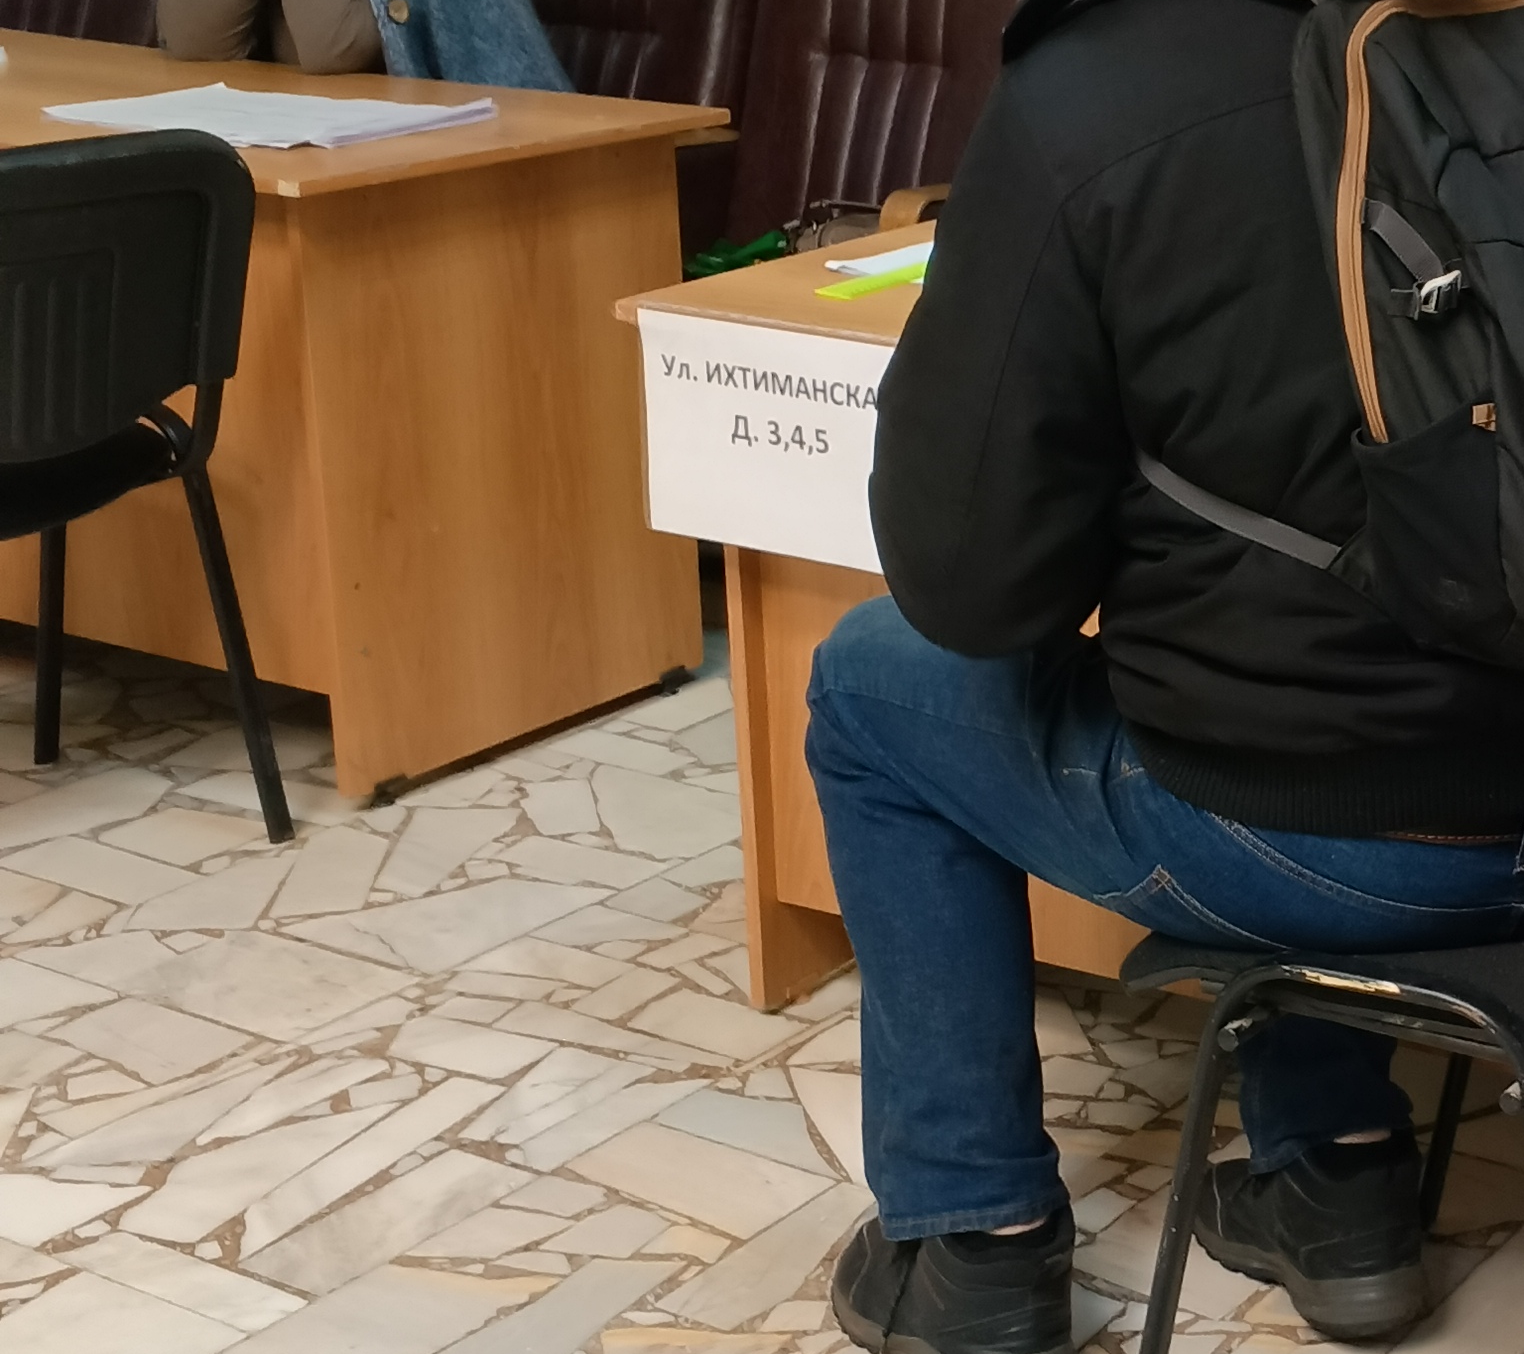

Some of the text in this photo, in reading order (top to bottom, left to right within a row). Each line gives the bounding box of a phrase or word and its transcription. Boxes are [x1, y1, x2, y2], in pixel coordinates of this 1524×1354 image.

[661, 353, 880, 411] Ул. ИХТИМАНСКА
[730, 414, 830, 456] Д. 3,4,5
